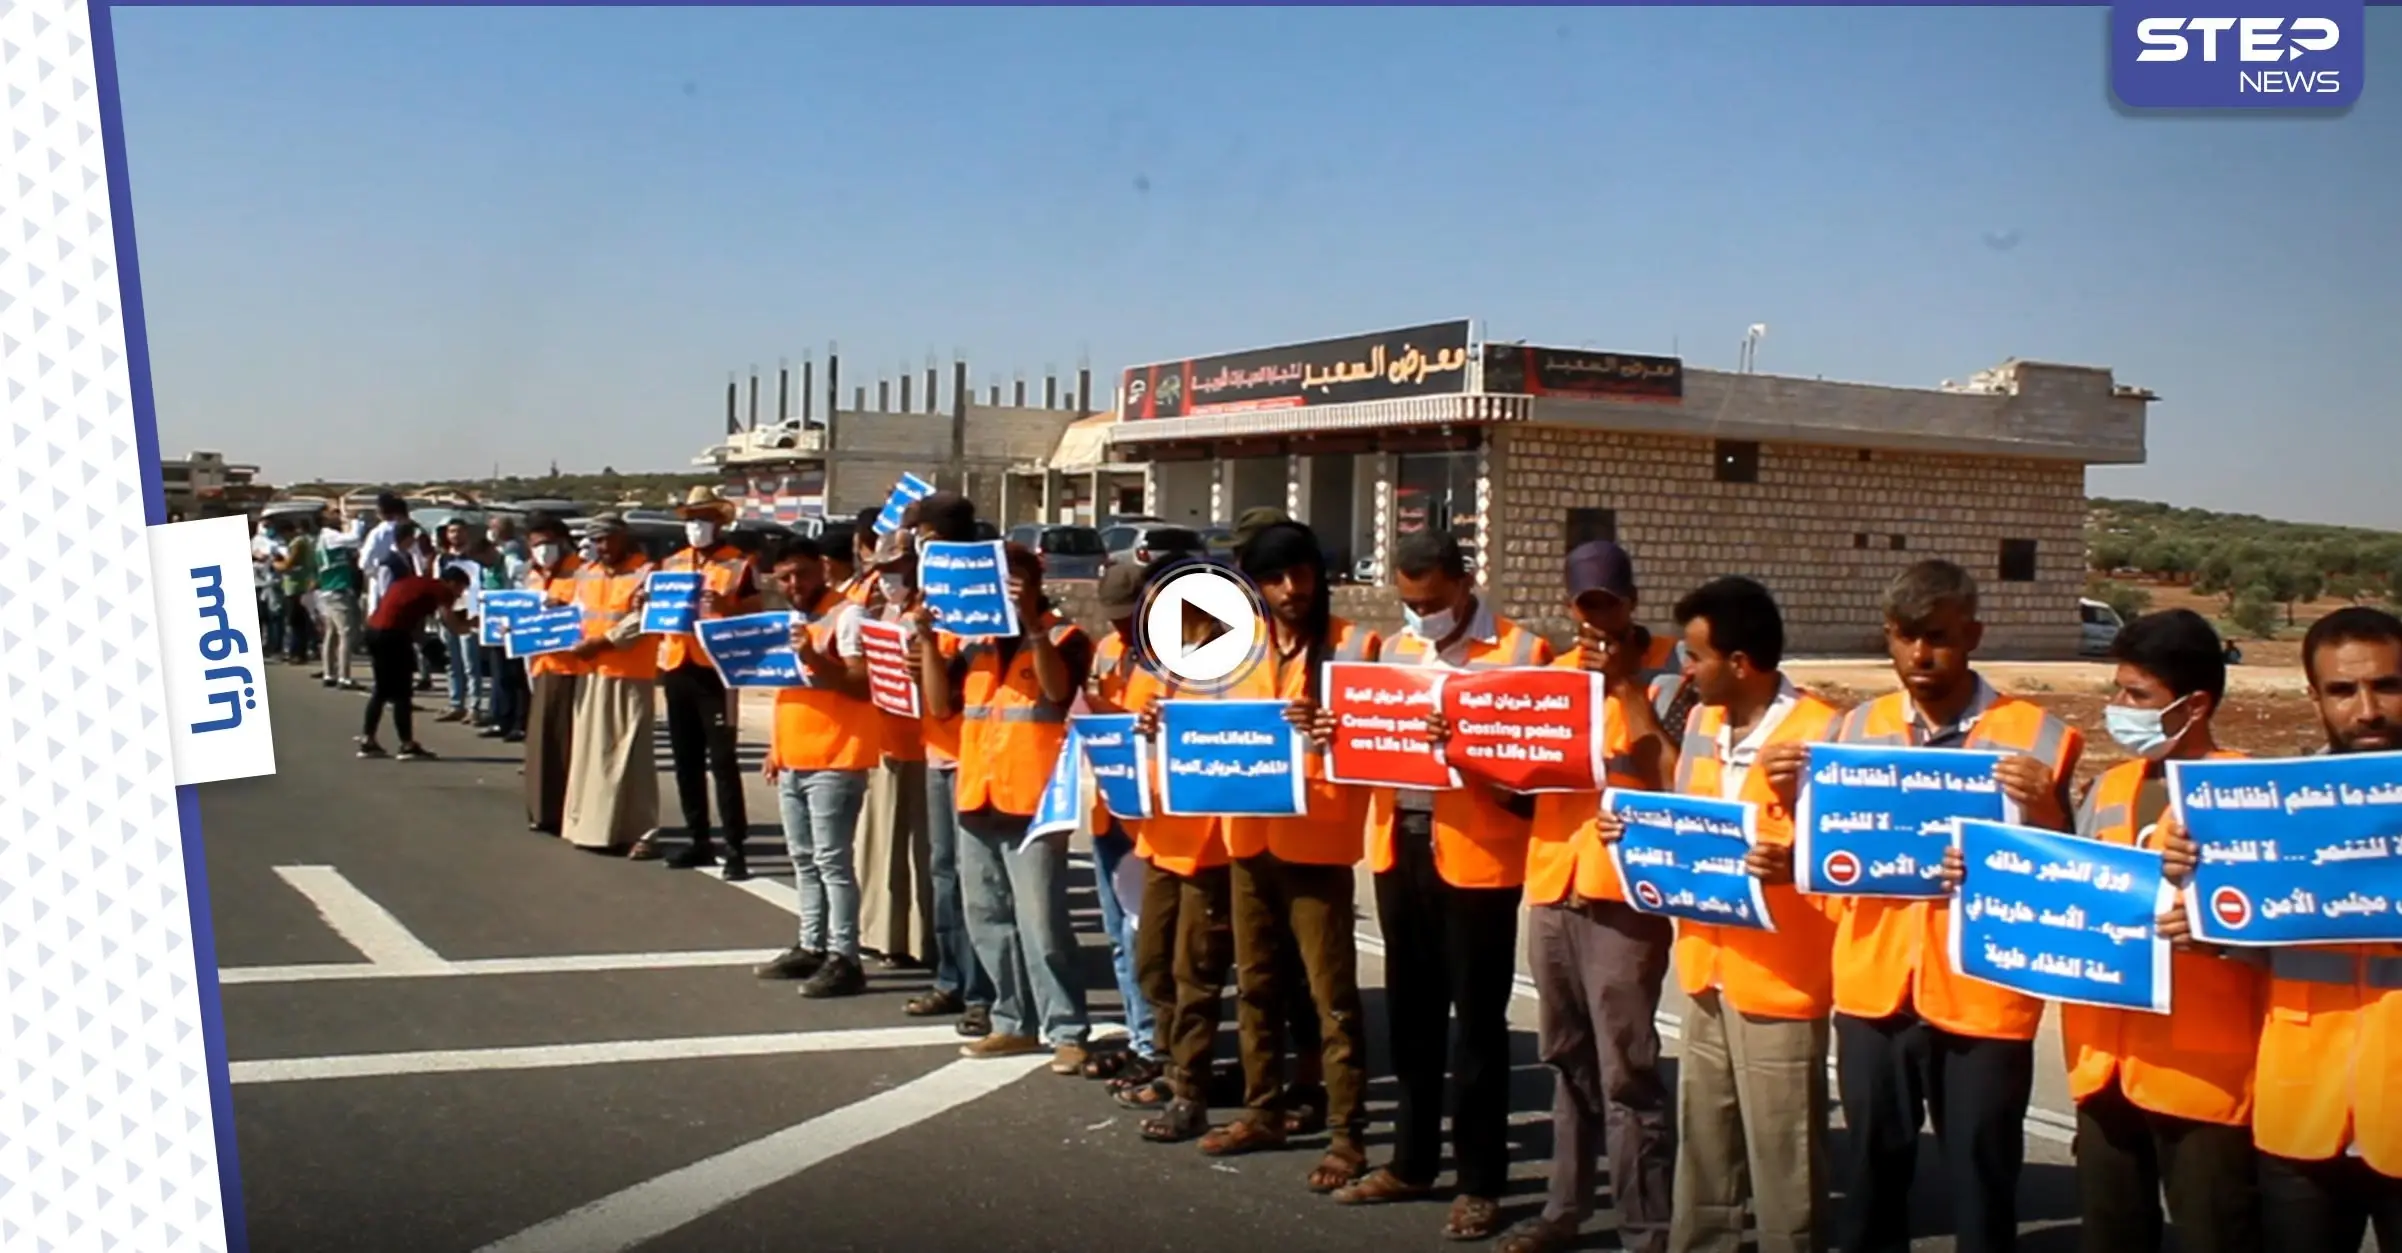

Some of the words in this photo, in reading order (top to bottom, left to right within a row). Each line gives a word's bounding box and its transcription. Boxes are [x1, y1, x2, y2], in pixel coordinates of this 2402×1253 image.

[1301, 344, 1386, 394] السعيد
[1388, 343, 1466, 384] معرض
[1458, 691, 1493, 709] الحياة
[1494, 693, 1533, 711] شريان
[1341, 713, 1396, 732] Crossing
[1397, 717, 1427, 732] poin
[1458, 718, 1522, 739] Crossing
[1524, 722, 1573, 739] points
[1181, 730, 1275, 745] #SaveLifeLine
[1350, 738, 1374, 750] are
[1374, 736, 1401, 752] Life
[1402, 736, 1431, 754] Line
[1466, 745, 1494, 758] are
[1495, 743, 1527, 760] Life
[1528, 744, 1564, 762] Line
[1813, 761, 1839, 785] أنه
[1840, 763, 1898, 787] أطفالنا
[1900, 769, 1943, 794] نعلم
[1945, 772, 1997, 793] عندما
[2185, 780, 2213, 810] أنه
[2214, 779, 2280, 809] أطفالنا
[2284, 784, 2337, 816] نعلم
[1819, 811, 1875, 833] للفيتو
[1876, 812, 1890, 831] لا
[1984, 849, 2033, 875] مذاقه
[2201, 839, 2259, 865] للفيتو
[2261, 839, 2277, 861] لا
[2310, 836, 2389, 866] للتنمر
[1868, 853, 1915, 879] الأمن
[2034, 860, 2093, 883] الشجر
[2093, 864, 2133, 892] ورق
[1964, 892, 1984, 922] في
[1984, 896, 2036, 925] حاربنا
[2260, 888, 2315, 919] الأمن
[2322, 891, 2388, 918] مجلس
[2038, 904, 2086, 931] الأسد
[2030, 952, 2083, 978] الغذاء
[2084, 959, 2123, 985] سلة
